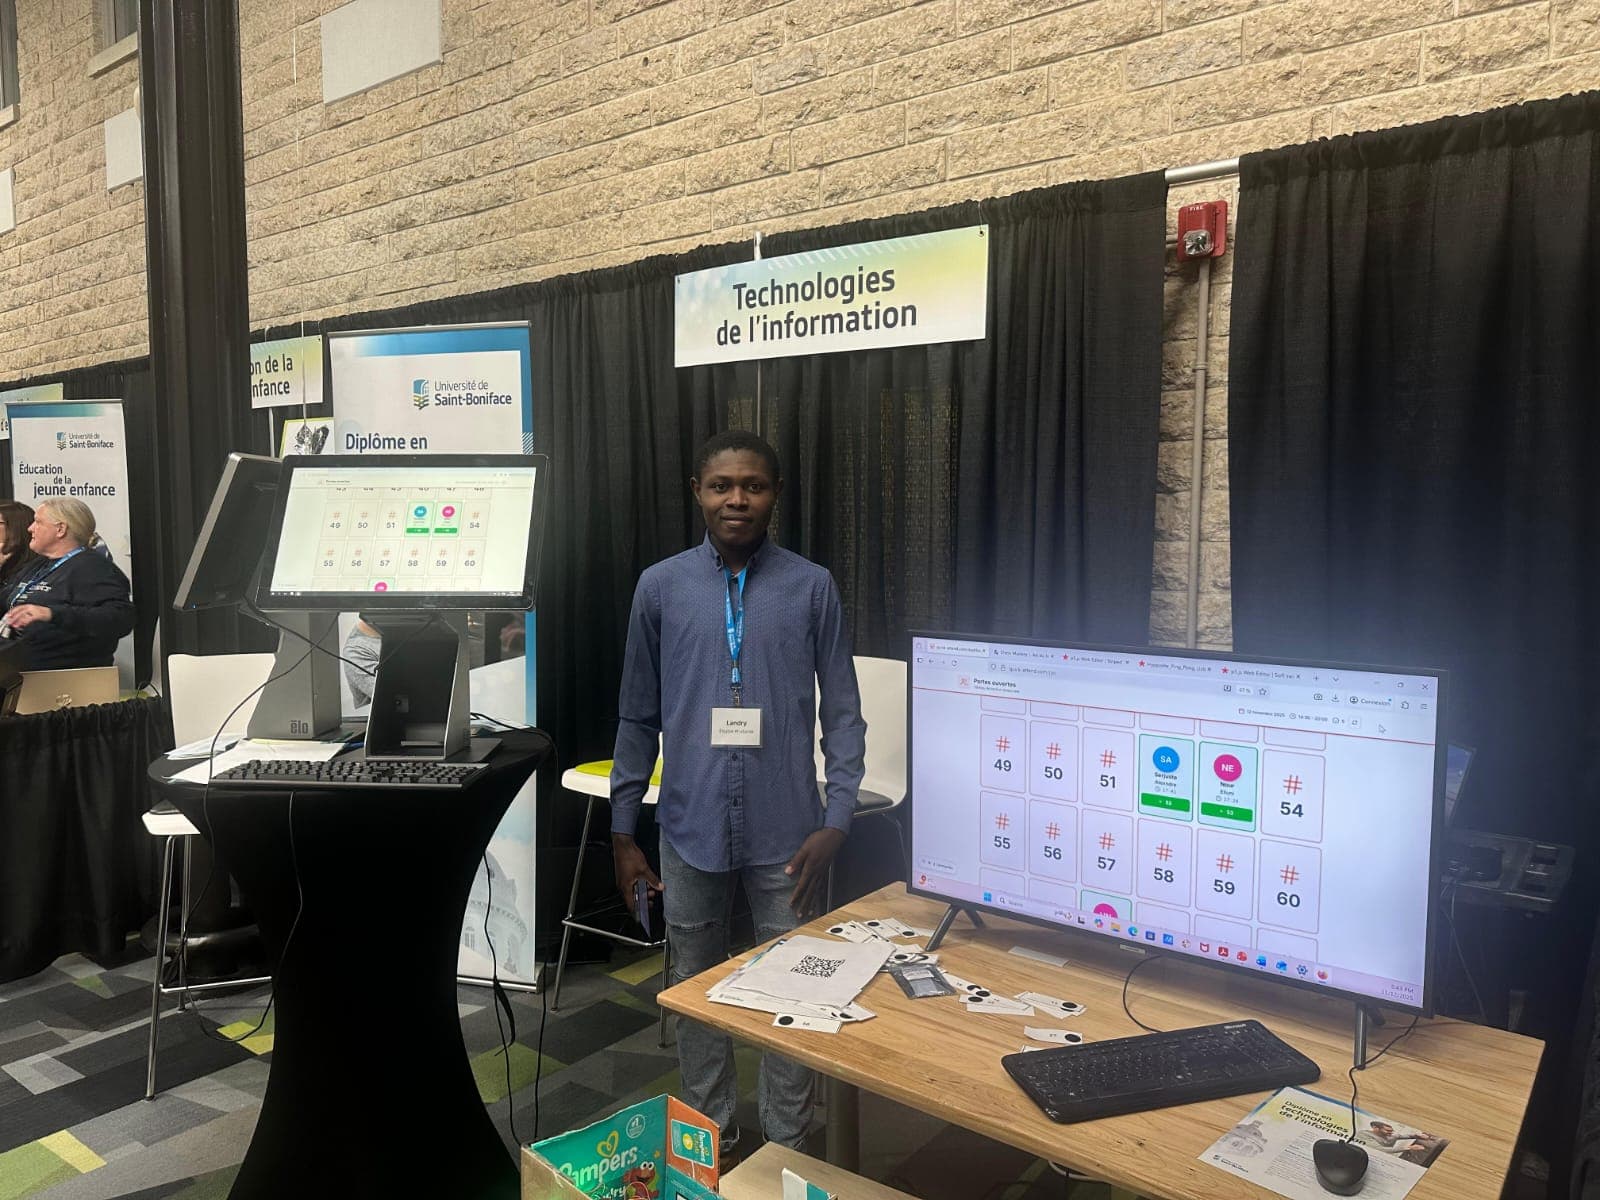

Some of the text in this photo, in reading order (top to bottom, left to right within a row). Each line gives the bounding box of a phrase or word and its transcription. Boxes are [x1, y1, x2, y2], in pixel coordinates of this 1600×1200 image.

[733, 265, 895, 311] Technologies
[717, 300, 917, 346] de l'information
[265, 355, 278, 373] de
[282, 353, 293, 372] la
[434, 379, 488, 391] Université de
[434, 391, 512, 406] Saint-Boniface
[68, 432, 94, 440] Université
[346, 432, 428, 453] Diplôme en
[69, 440, 114, 449] Saint-Boniface
[19, 461, 63, 475] Éducation
[53, 475, 72, 485] de la
[33, 482, 116, 499] jeune enfance
[1160, 755, 1172, 764] SA
[994, 758, 1116, 789] 49 50 51
[1221, 763, 1234, 773] NE
[1280, 802, 1304, 818] 54
[994, 835, 1300, 908] 55 56 57 58 59 60
[1279, 1110, 1293, 1118] de
[1285, 1101, 1320, 1116] Diplôme
[1281, 1105, 1349, 1133] technologies
